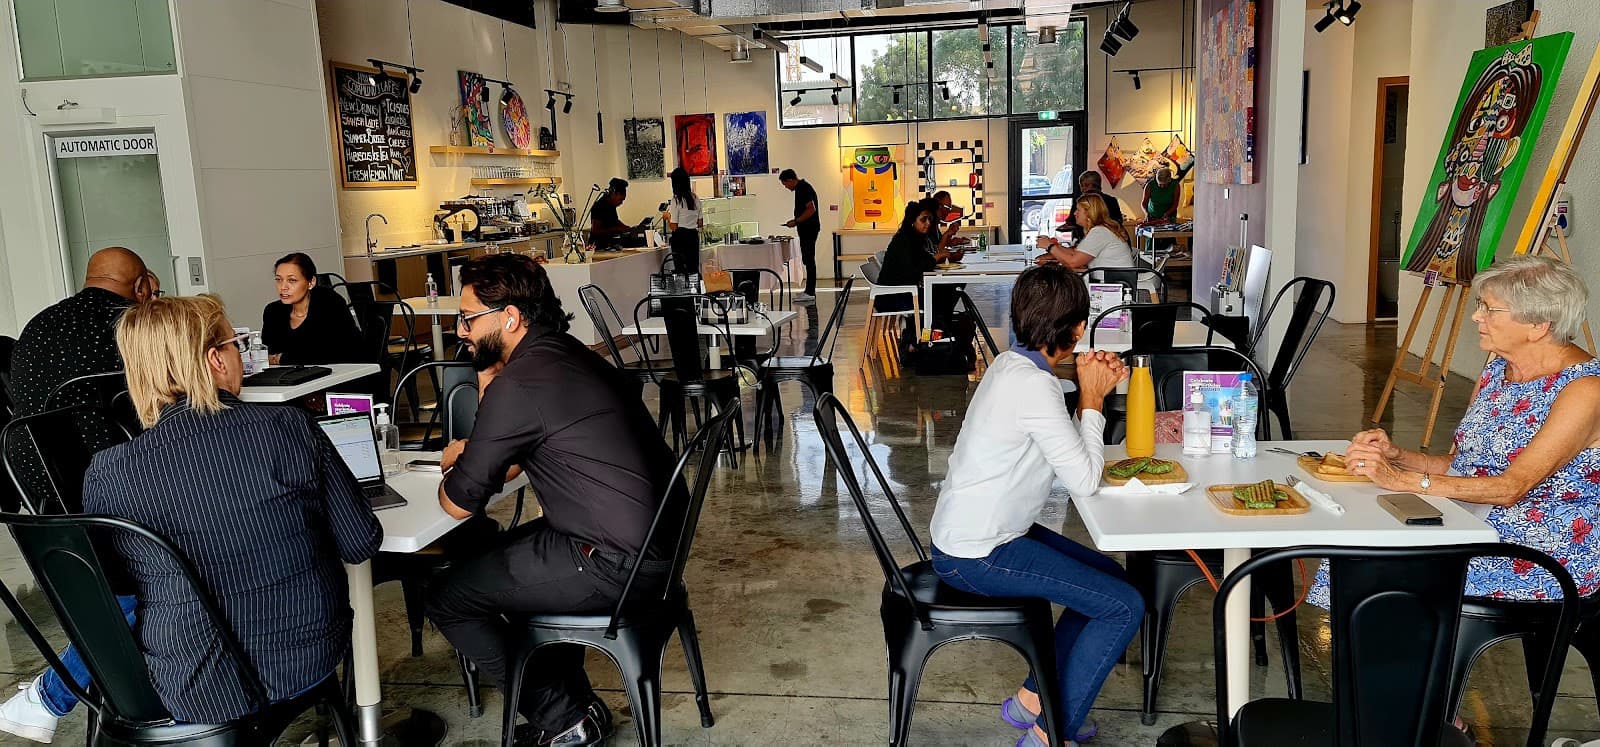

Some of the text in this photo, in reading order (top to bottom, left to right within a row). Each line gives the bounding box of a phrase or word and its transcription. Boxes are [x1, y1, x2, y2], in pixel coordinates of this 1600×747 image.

[60, 138, 154, 153] AUTOMATIC DOOR
[347, 165, 368, 182] FRESH
